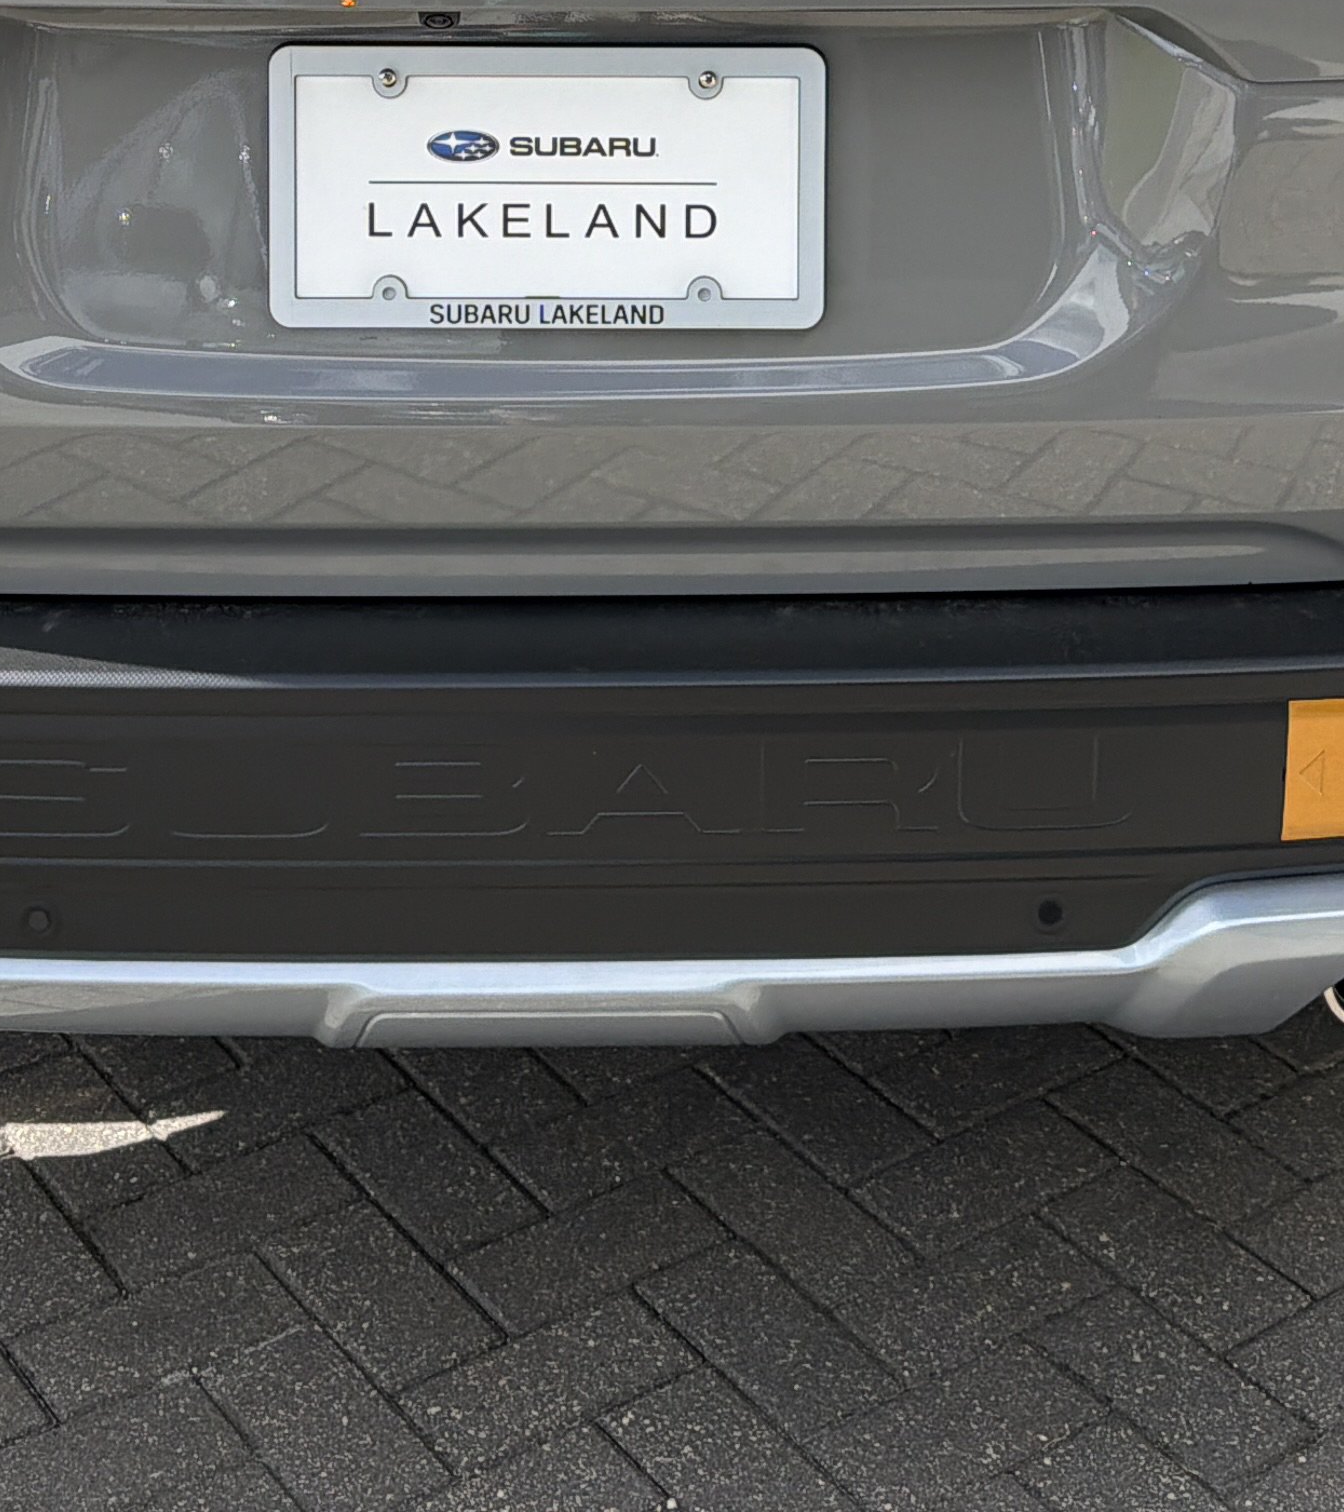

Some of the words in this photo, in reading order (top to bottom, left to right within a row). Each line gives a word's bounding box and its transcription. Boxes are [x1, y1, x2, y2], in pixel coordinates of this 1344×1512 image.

[509, 136, 657, 157] SUBARU
[367, 202, 718, 239] LAKELAND
[429, 304, 530, 325] SUBARU
[539, 304, 665, 325] LAKELAND
